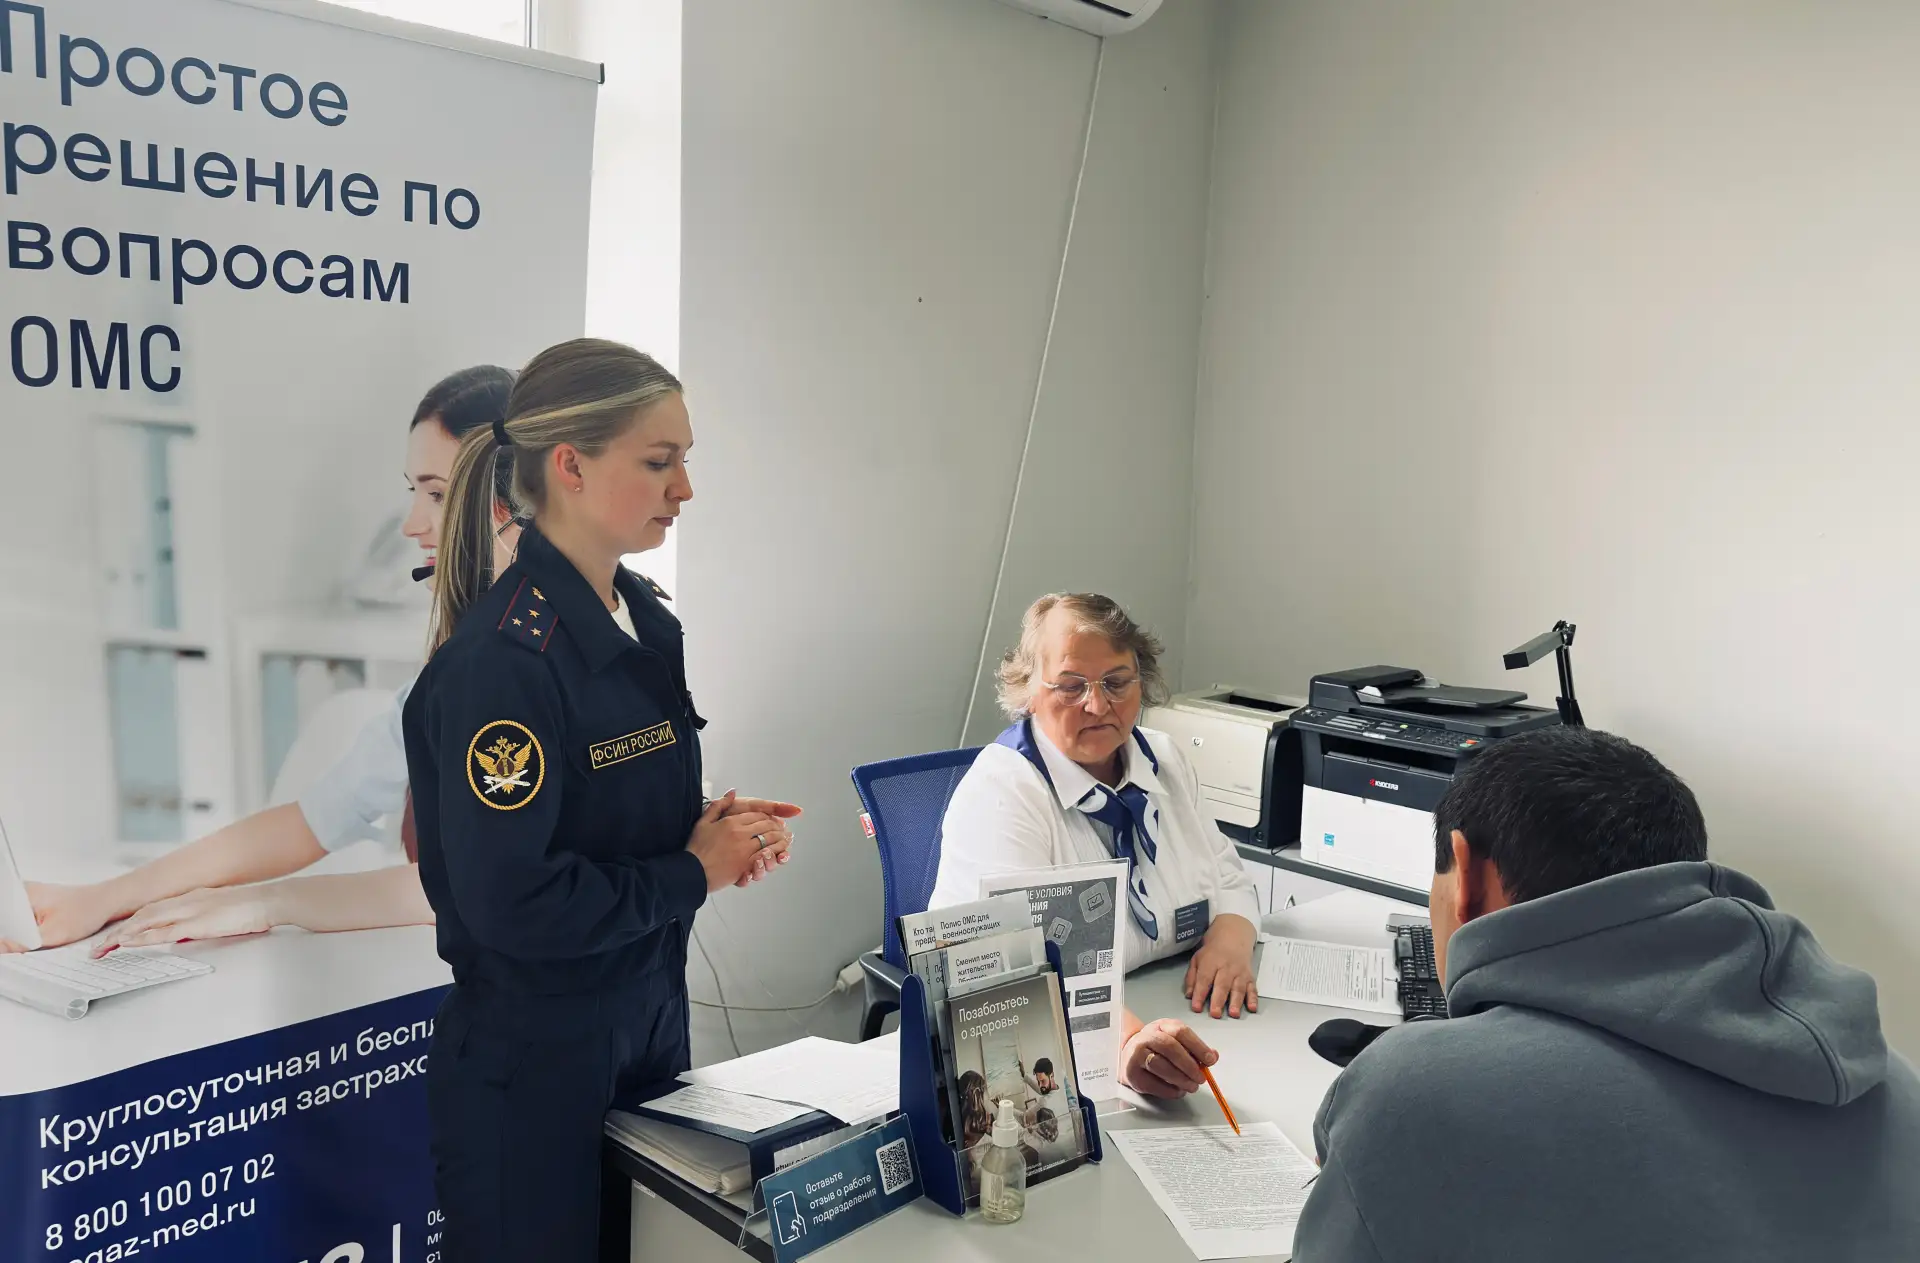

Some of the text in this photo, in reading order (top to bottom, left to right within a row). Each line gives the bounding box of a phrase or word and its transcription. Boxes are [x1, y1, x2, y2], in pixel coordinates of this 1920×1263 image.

[0, 1, 348, 126] Простое
[3, 122, 481, 230] решение по
[7, 220, 410, 304] вопросам
[10, 315, 181, 392] ОМС
[594, 726, 672, 763] ФСИН РОССИИ
[1035, 886, 1073, 899] УСЛОВИЯ
[913, 926, 934, 937] Кто та
[940, 914, 990, 930] Полис ОМС для
[942, 921, 1001, 940] военнослужащих
[956, 951, 1001, 967] Сменил место
[957, 960, 998, 977] жительства?
[959, 996, 1029, 1023] Позаботьтесь
[961, 1015, 1019, 1040] о здоровье
[39, 1050, 320, 1152] Круглосуточная
[330, 1042, 347, 1065] и
[41, 1094, 288, 1189] консультация
[805, 1171, 843, 1195] Оставьте
[809, 1174, 872, 1210] отзыв о работе
[45, 1153, 275, 1251] 8 800 100 07 02
[812, 1187, 877, 1226] подразделения
